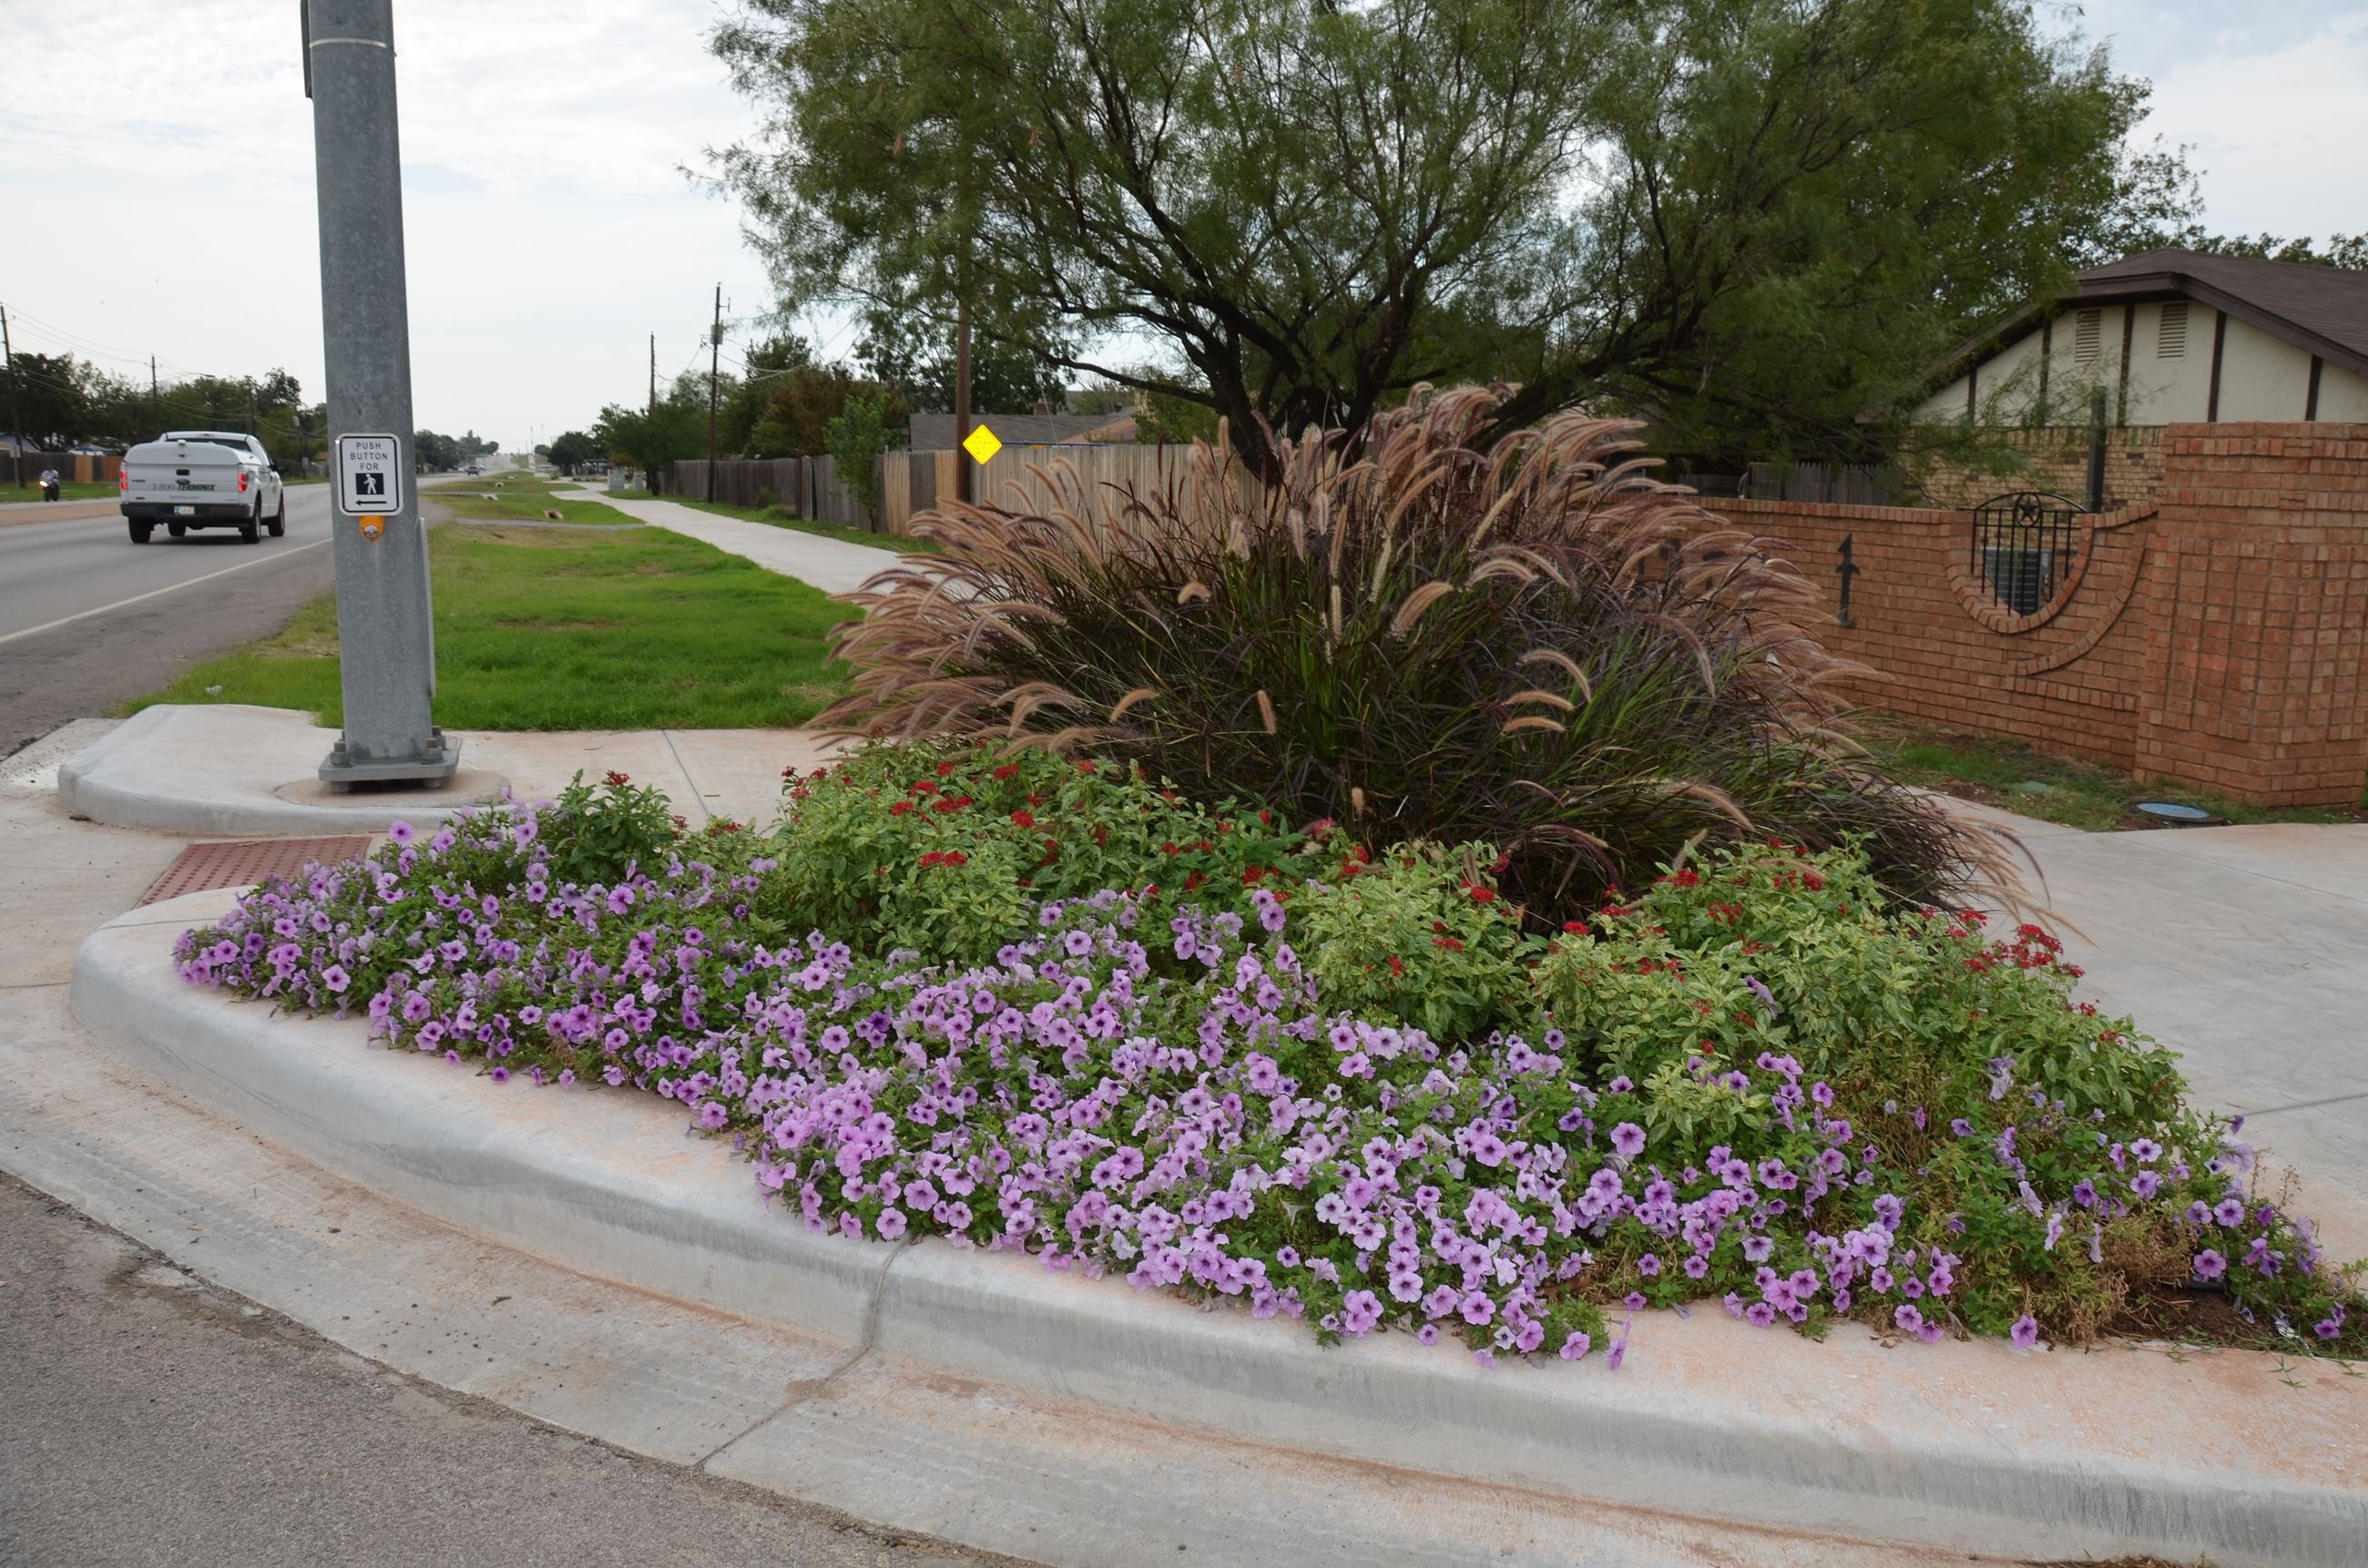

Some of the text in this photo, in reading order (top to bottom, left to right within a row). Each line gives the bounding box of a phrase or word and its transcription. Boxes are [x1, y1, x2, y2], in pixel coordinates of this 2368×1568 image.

[356, 442, 382, 450] PUSH
[350, 452, 388, 460] BUTTON
[360, 463, 379, 471] FOR
